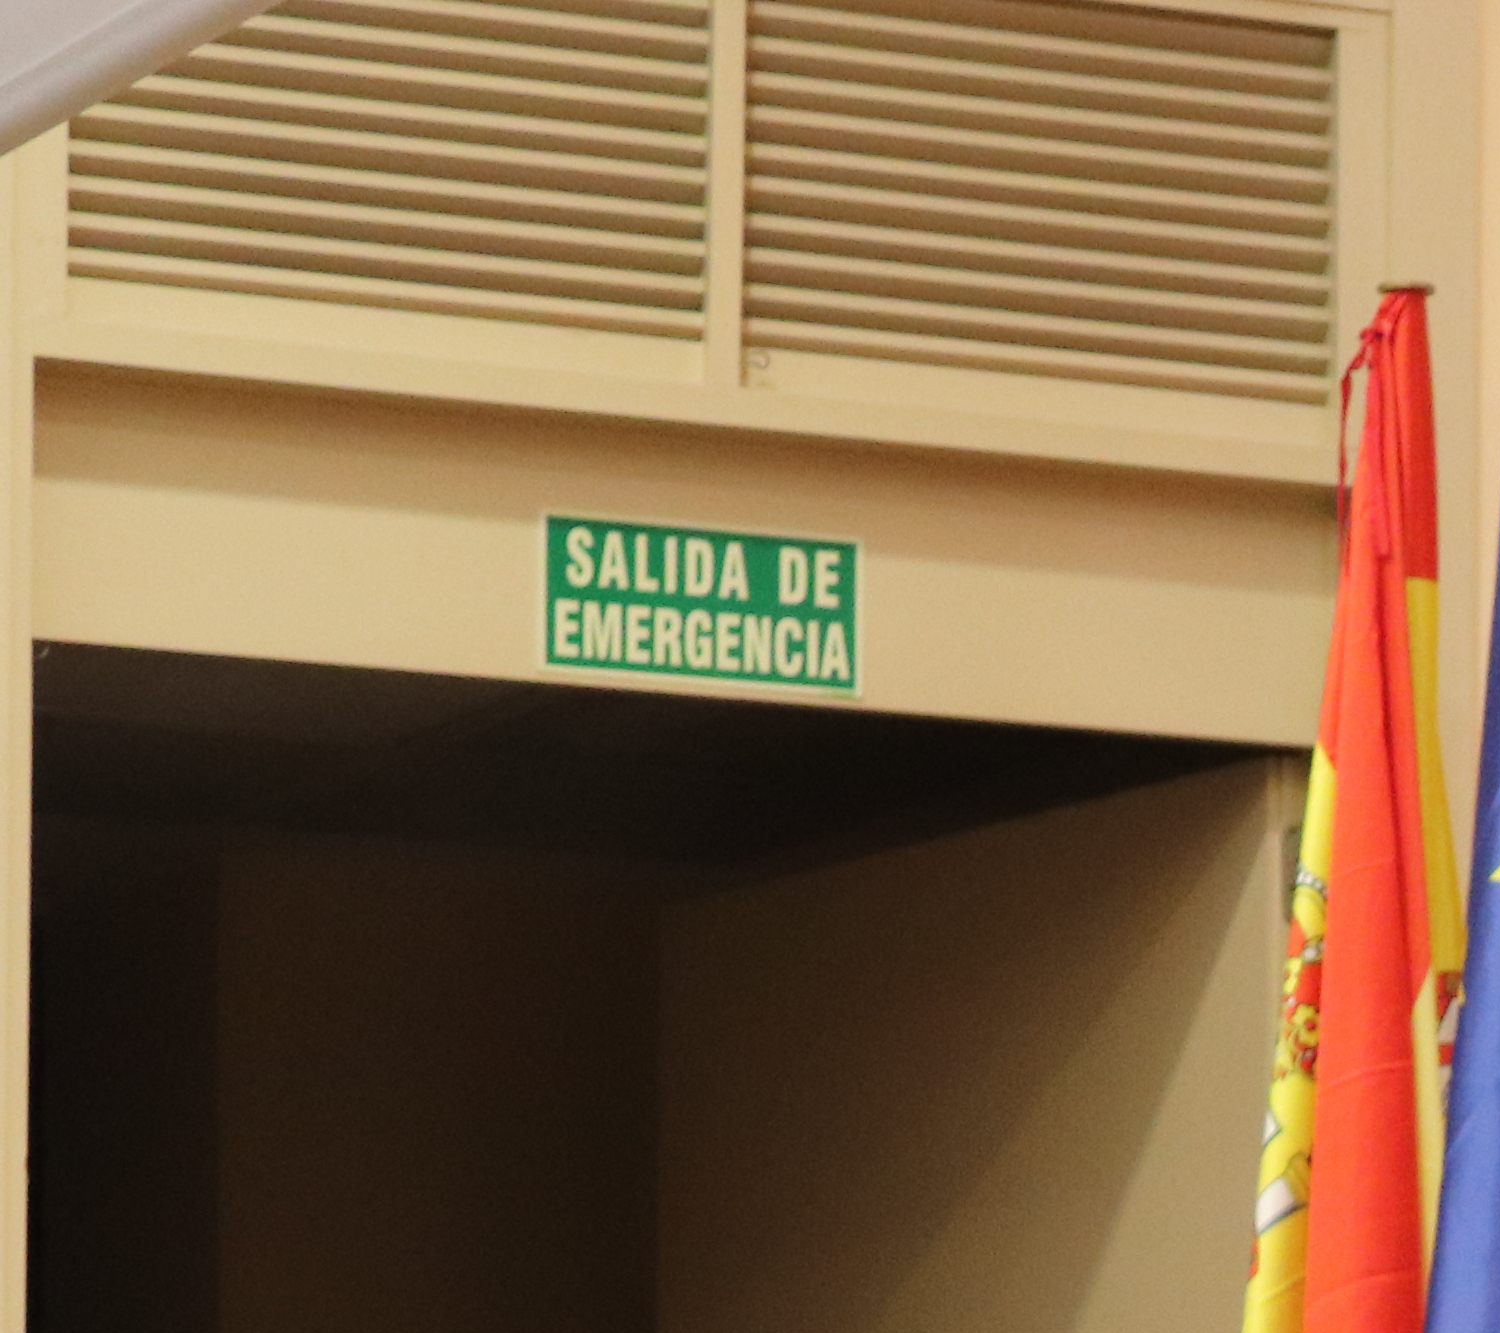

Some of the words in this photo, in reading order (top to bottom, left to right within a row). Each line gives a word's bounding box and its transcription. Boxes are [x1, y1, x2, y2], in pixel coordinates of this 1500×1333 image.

[565, 526, 750, 601] SALIDA
[777, 545, 841, 609] DE
[553, 598, 850, 681] EMERGENCIA
